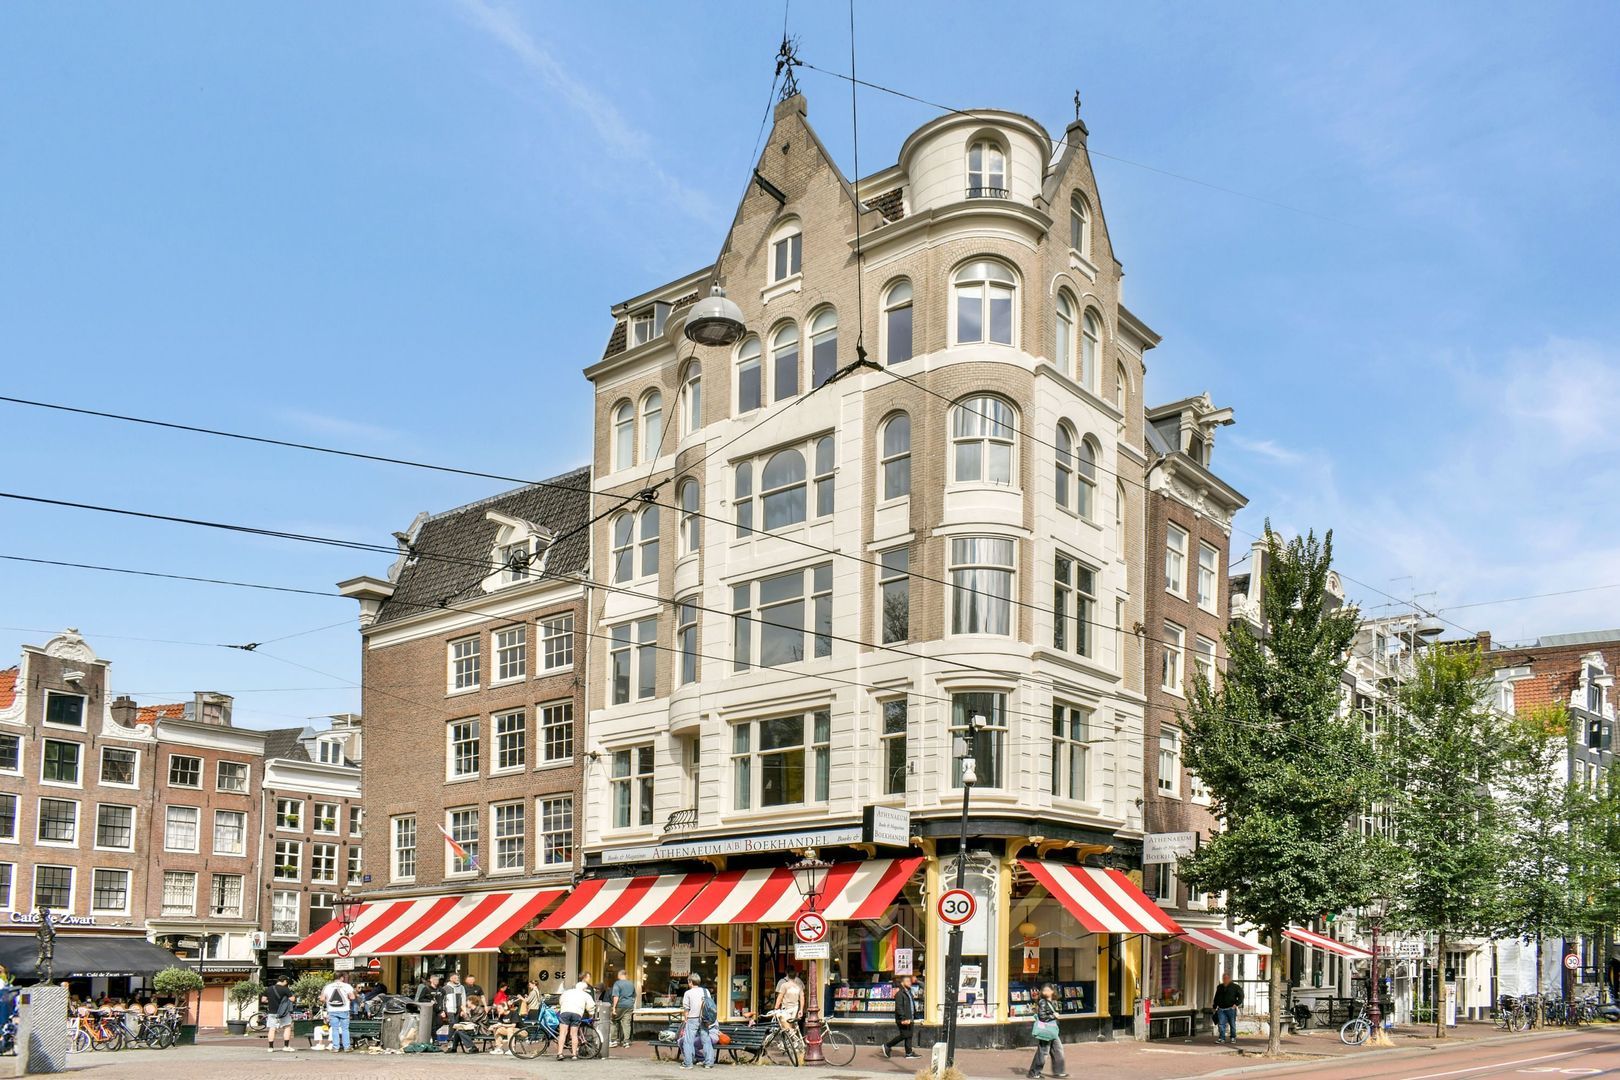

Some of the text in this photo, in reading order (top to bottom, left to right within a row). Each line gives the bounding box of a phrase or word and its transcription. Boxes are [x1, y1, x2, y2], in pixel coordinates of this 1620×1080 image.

[876, 811, 908, 821] ATHENAEUM
[875, 830, 908, 842] BOEKHANDEL
[1148, 836, 1192, 844] ATHENAEUM
[653, 844, 721, 859] ATHENAEUM
[745, 835, 830, 851] BOEKHANDEL
[837, 834, 852, 842] Books
[944, 900, 969, 914] 30
[11, 911, 39, 923] Café
[60, 913, 96, 925] Zwart
